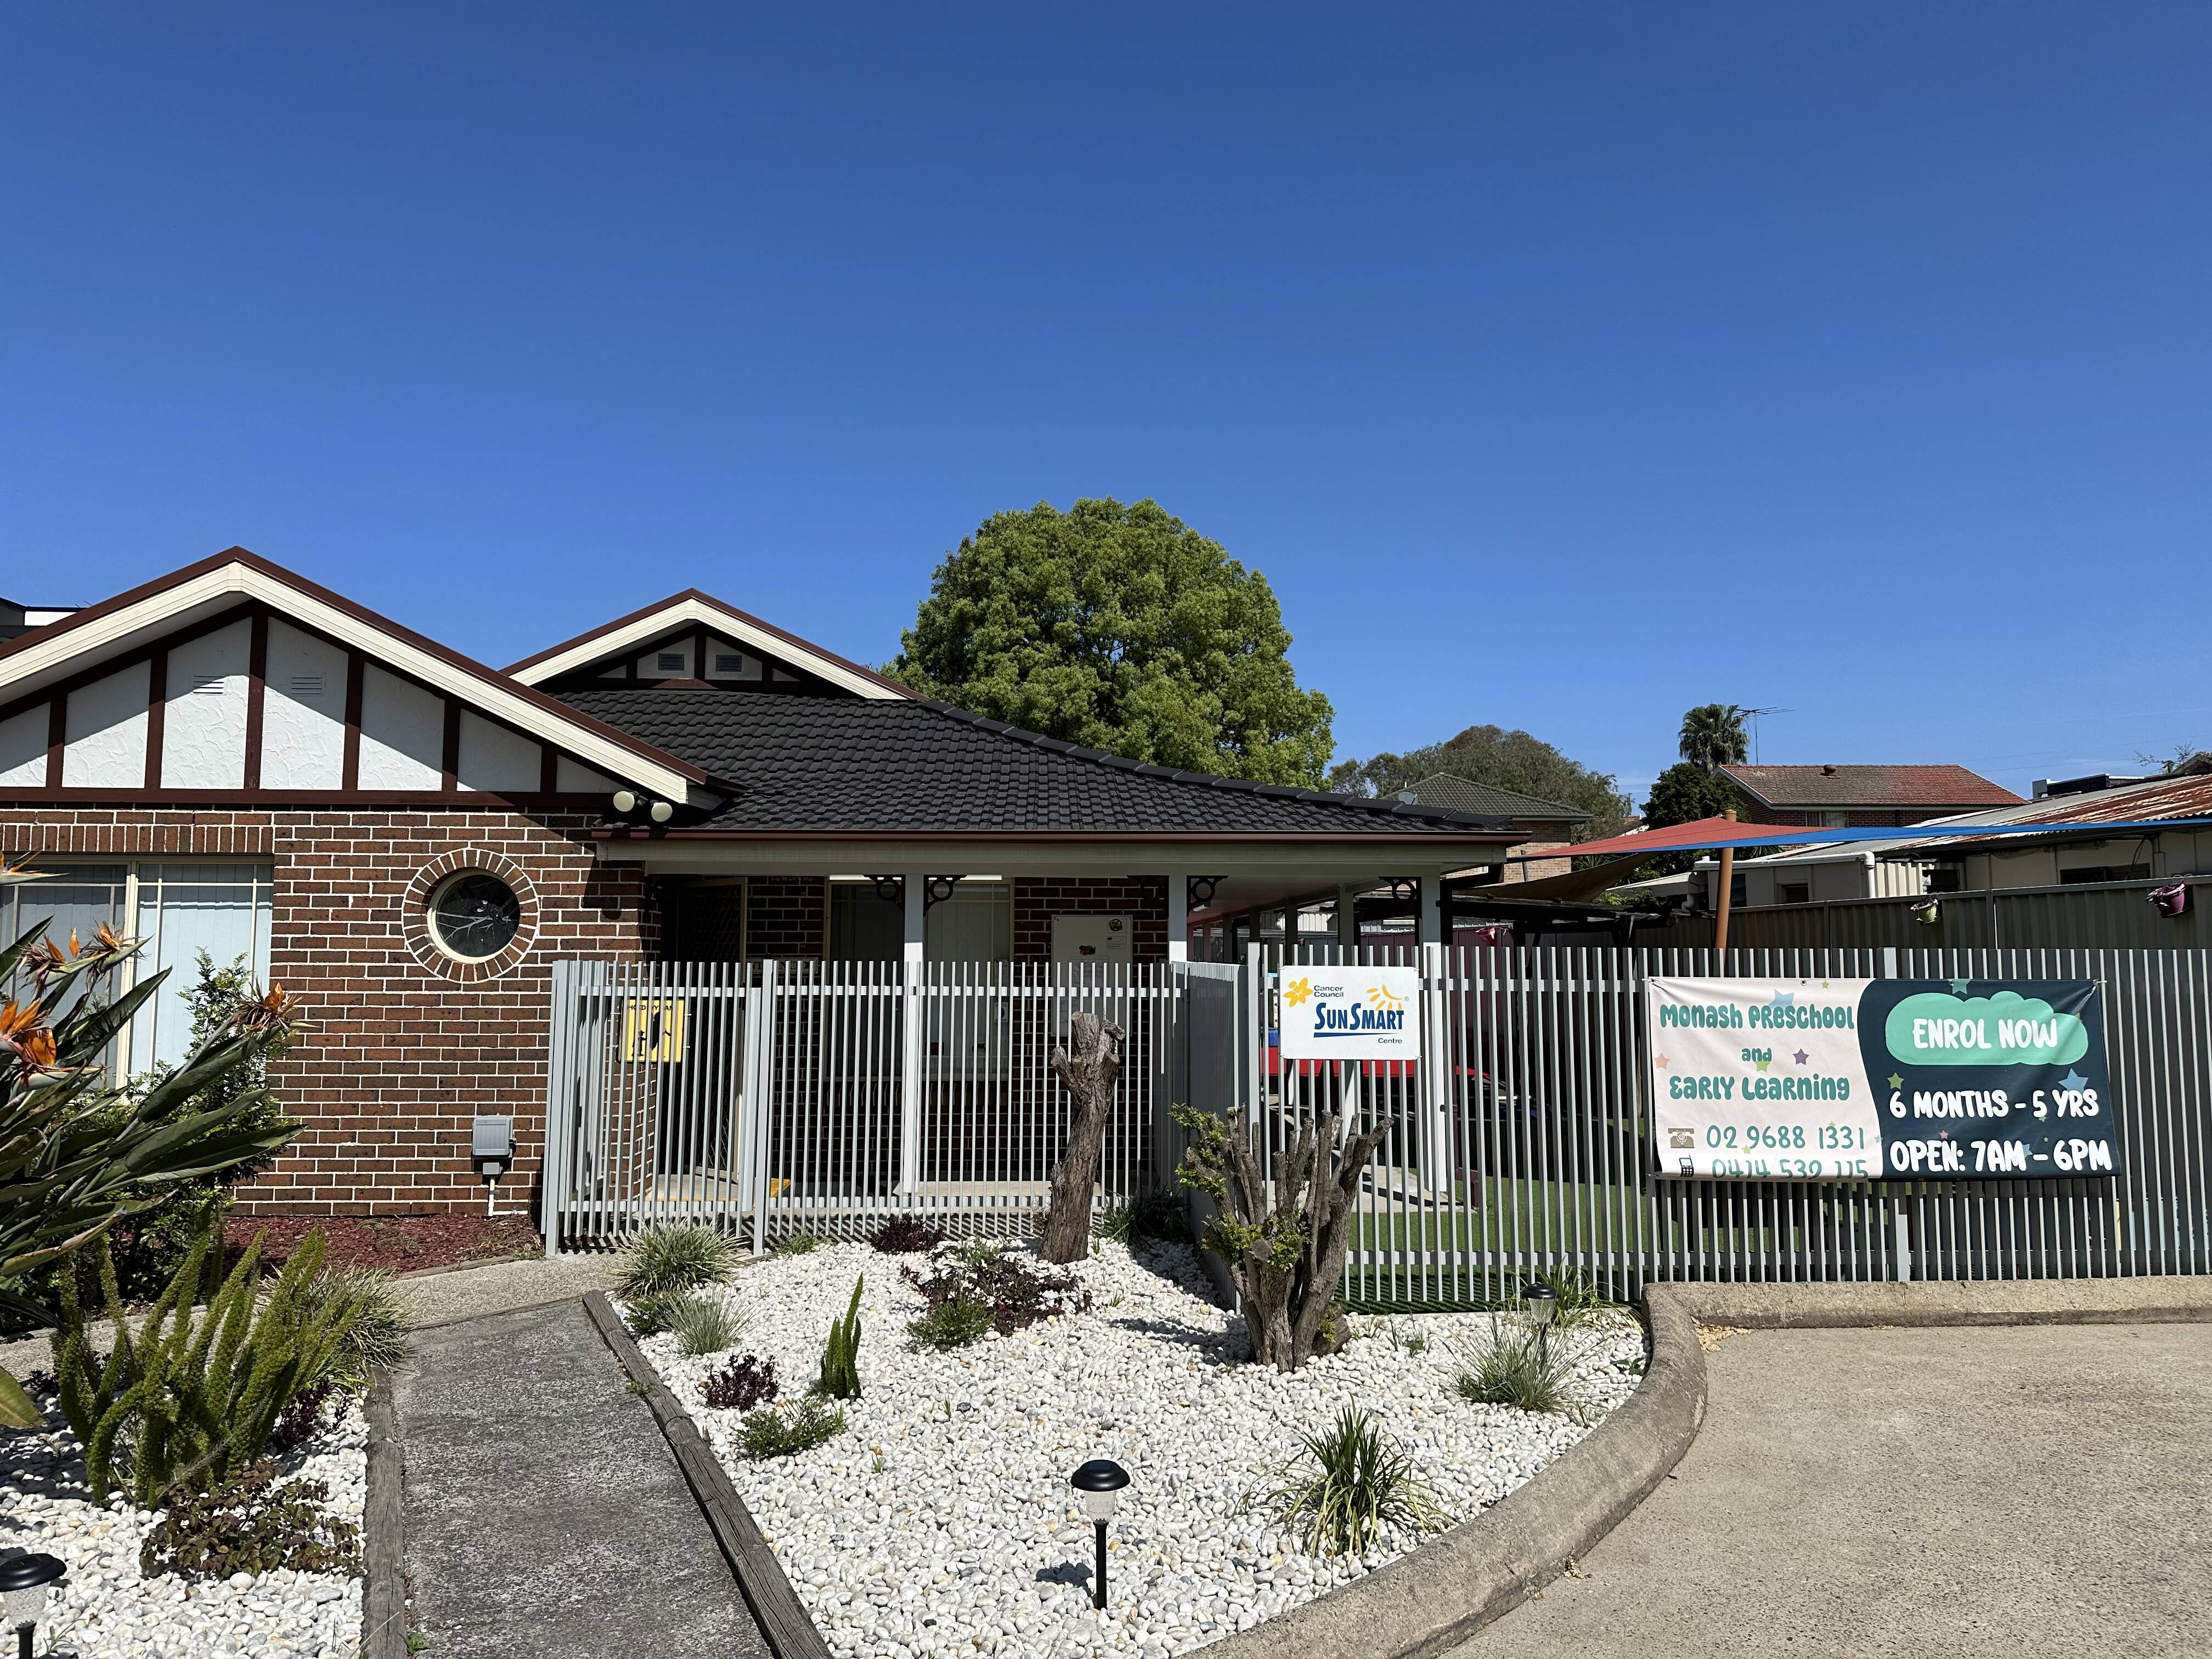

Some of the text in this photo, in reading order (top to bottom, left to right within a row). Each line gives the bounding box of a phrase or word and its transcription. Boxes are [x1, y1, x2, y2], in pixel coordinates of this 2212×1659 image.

[1912, 1018, 2058, 1049] ENROL NOW
[1741, 1047, 1772, 1062] and
[1889, 1091, 1907, 1119] 6
[1913, 1089, 2009, 1119] MONTHS
[2032, 1090, 2047, 1118] 5
[2051, 1088, 2100, 1118] YRS
[1706, 1125, 1865, 1149] 02 9688 1331
[1889, 1139, 1966, 1172] OPEN:
[1971, 1139, 2027, 1172] 7AM
[2052, 1138, 2113, 1171] 6PM
